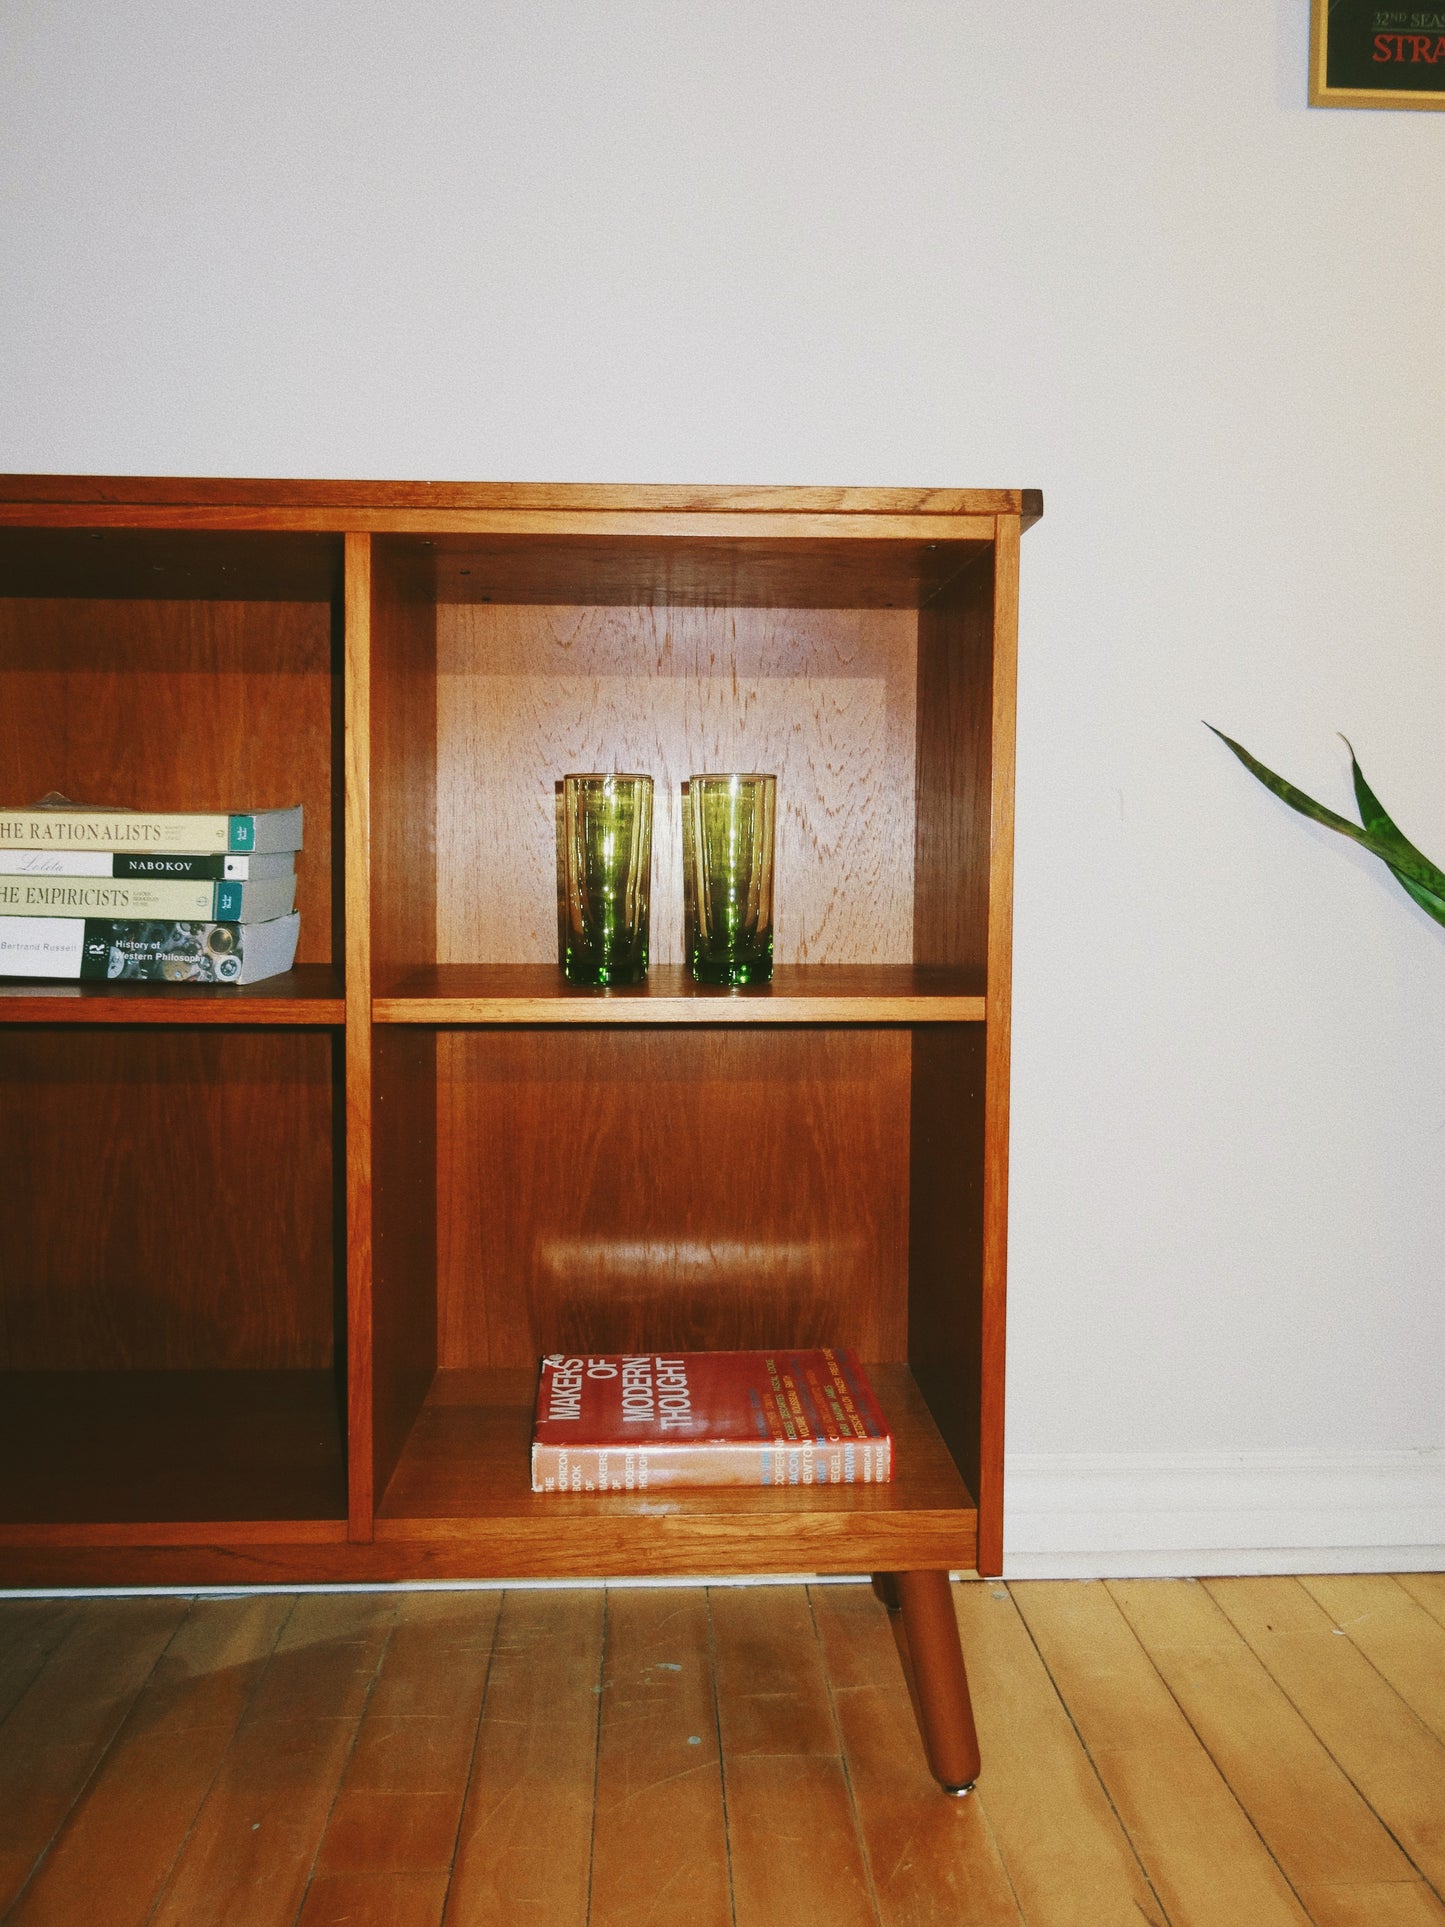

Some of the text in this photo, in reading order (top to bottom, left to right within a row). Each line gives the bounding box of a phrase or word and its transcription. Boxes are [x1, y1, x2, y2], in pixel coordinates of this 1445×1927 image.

[1372, 33, 1445, 64] STRA
[29, 823, 161, 842] RATIONALISTS
[128, 860, 193, 872] NABOKOV
[26, 887, 130, 907] EMPIRICISTS
[0, 941, 78, 953] Bertrand Russell
[115, 940, 161, 951] History of
[115, 952, 206, 963] Western Philosophy
[586, 1358, 619, 1379] OF
[548, 1357, 585, 1420] MAKERS
[621, 1357, 655, 1422] MODERN
[655, 1356, 693, 1430] THOUGHT
[572, 1464, 582, 1491] BOOK
[585, 1479, 595, 1491] OF
[612, 1479, 622, 1490] OF
